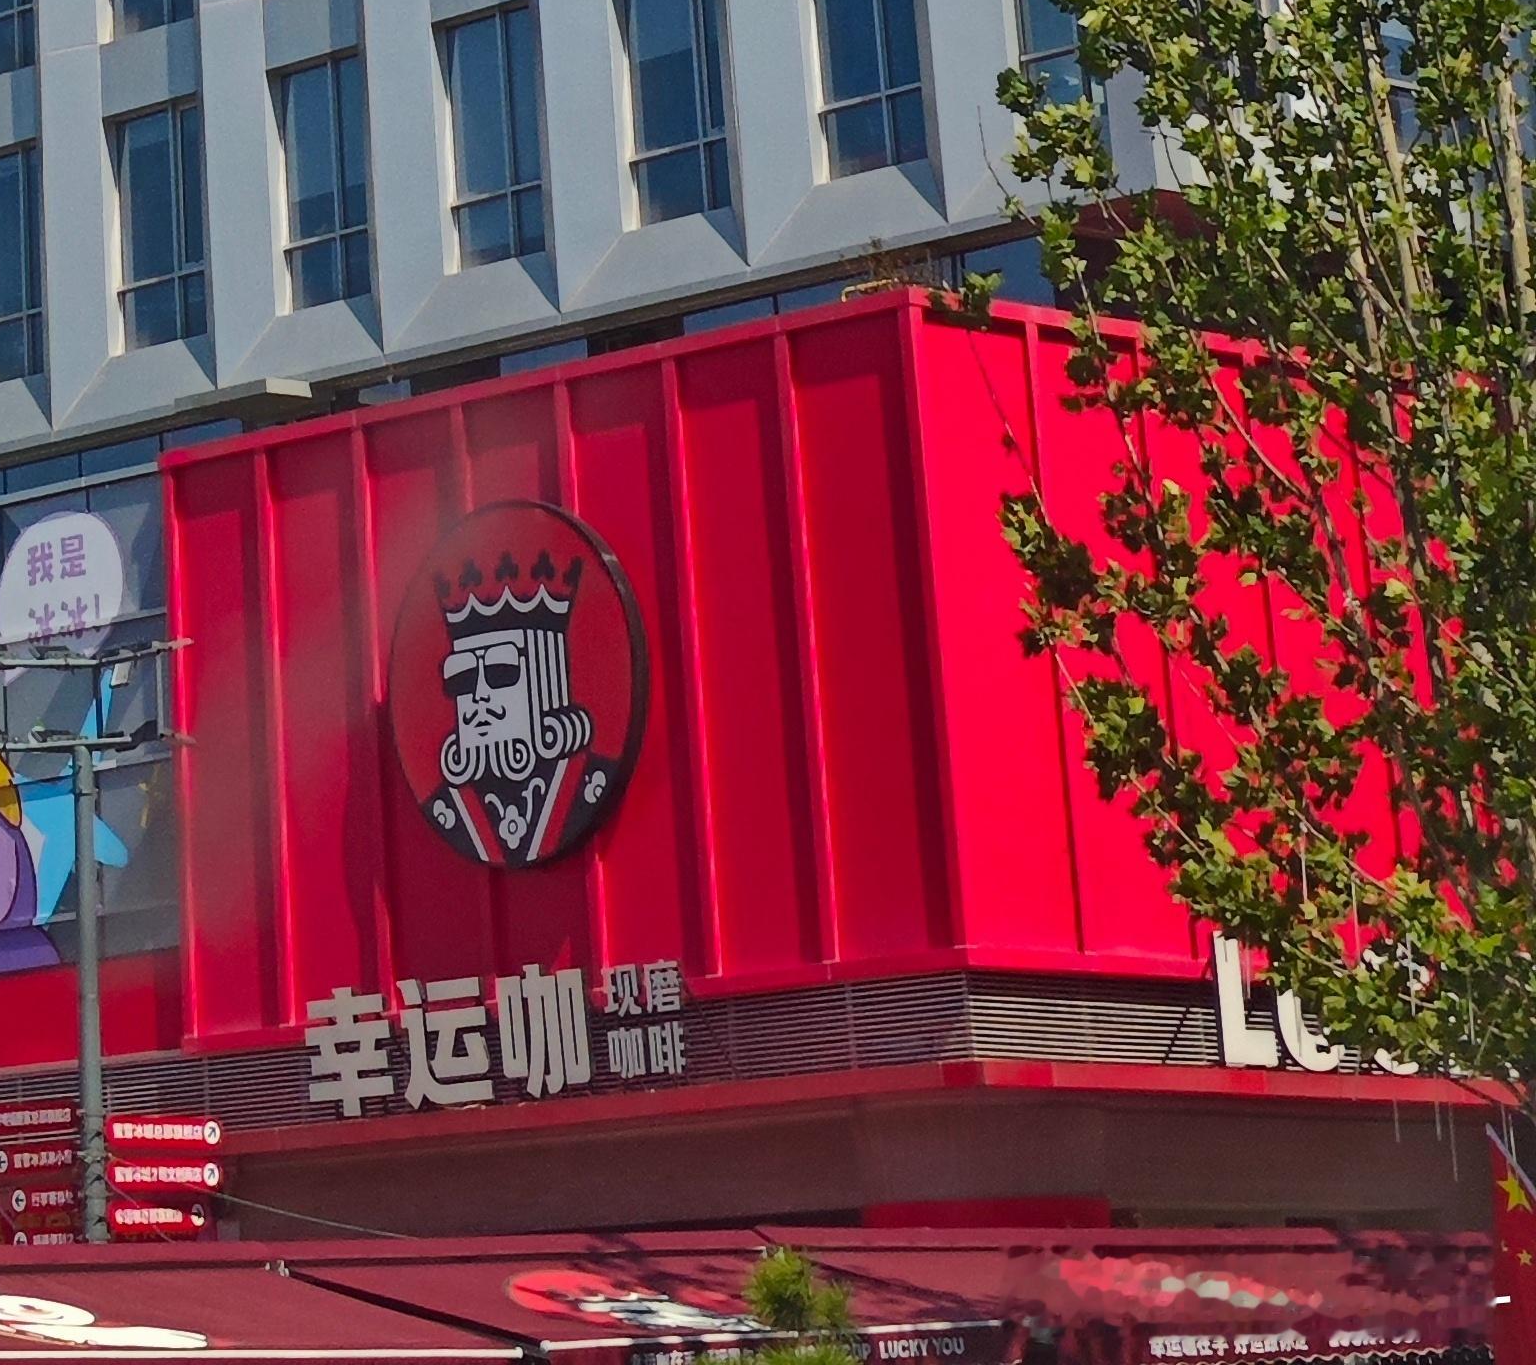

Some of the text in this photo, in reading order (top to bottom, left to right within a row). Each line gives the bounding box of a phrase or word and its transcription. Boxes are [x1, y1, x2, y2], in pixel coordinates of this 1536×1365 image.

[27, 533, 87, 587] 我是
[600, 959, 683, 1018] 现磨
[304, 963, 592, 1117] 幸运咖
[607, 1020, 687, 1080] 咖啡
[878, 1338, 929, 1360] LUCKY
[932, 1336, 965, 1356] YOU
